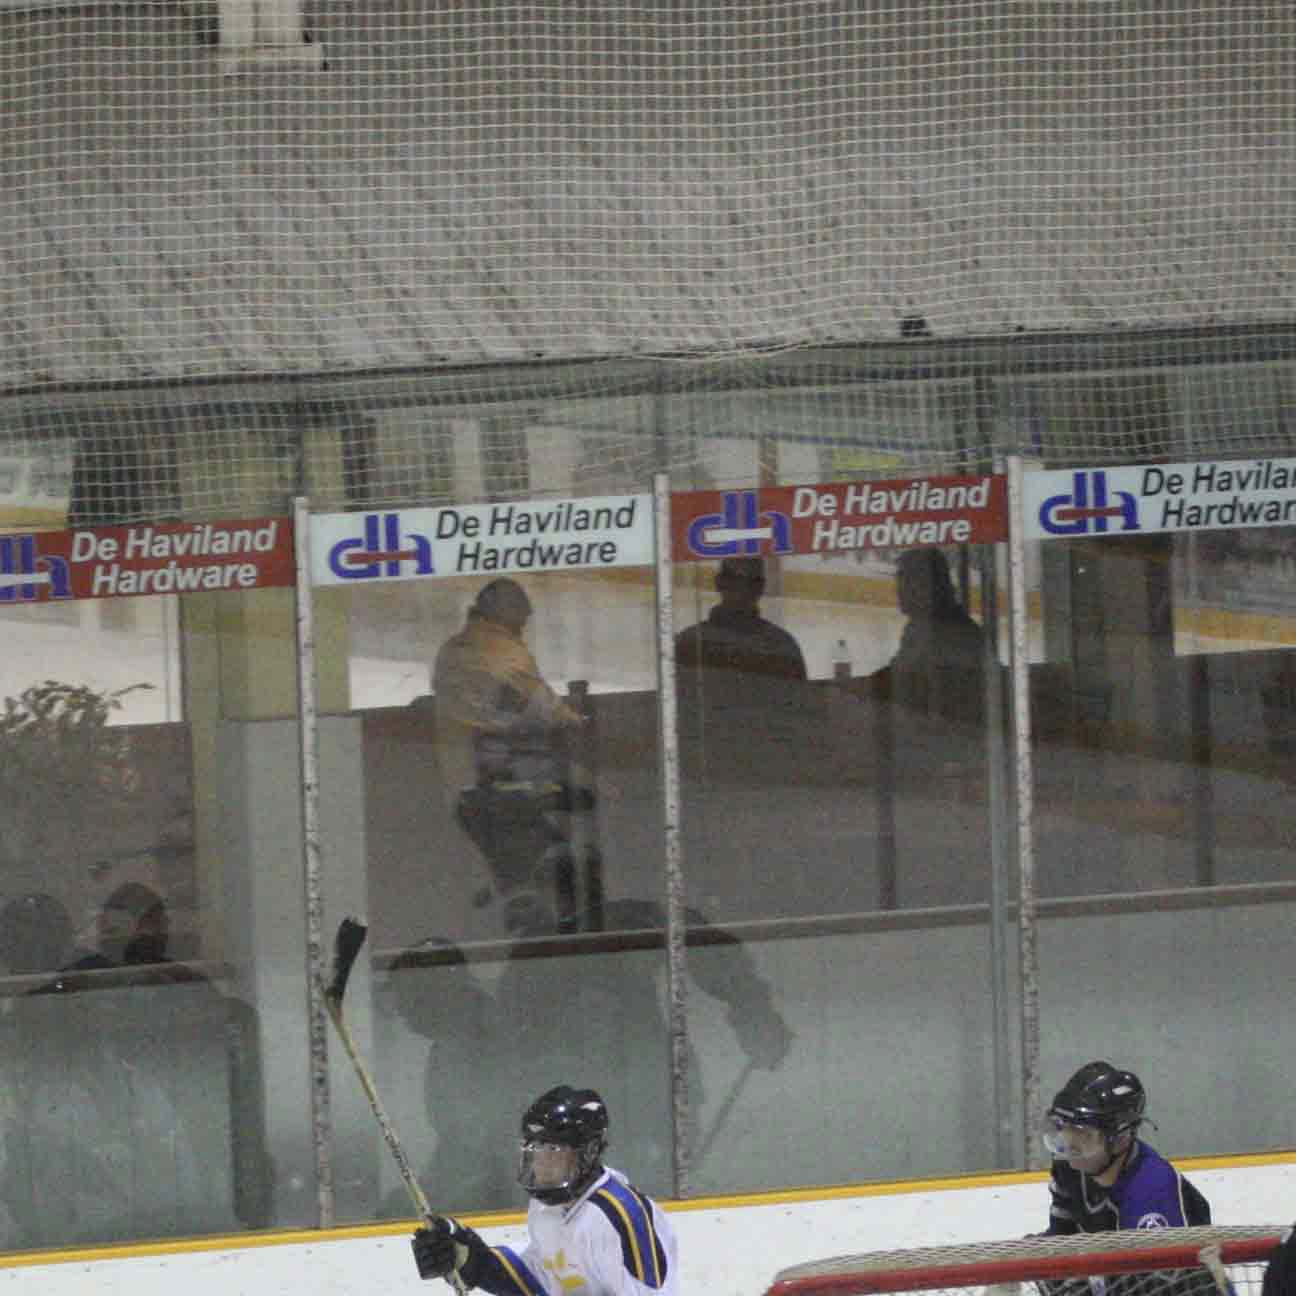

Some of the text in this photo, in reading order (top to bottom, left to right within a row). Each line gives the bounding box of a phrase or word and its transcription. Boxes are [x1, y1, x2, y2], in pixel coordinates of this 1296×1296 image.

[792, 478, 990, 518] De Haviland
[1141, 468, 1184, 496] De
[435, 500, 636, 539] De Haviland
[813, 517, 971, 550] Hardware
[71, 522, 277, 562] De Haviland
[457, 539, 617, 572] Hardware
[92, 561, 257, 595] Hardware
